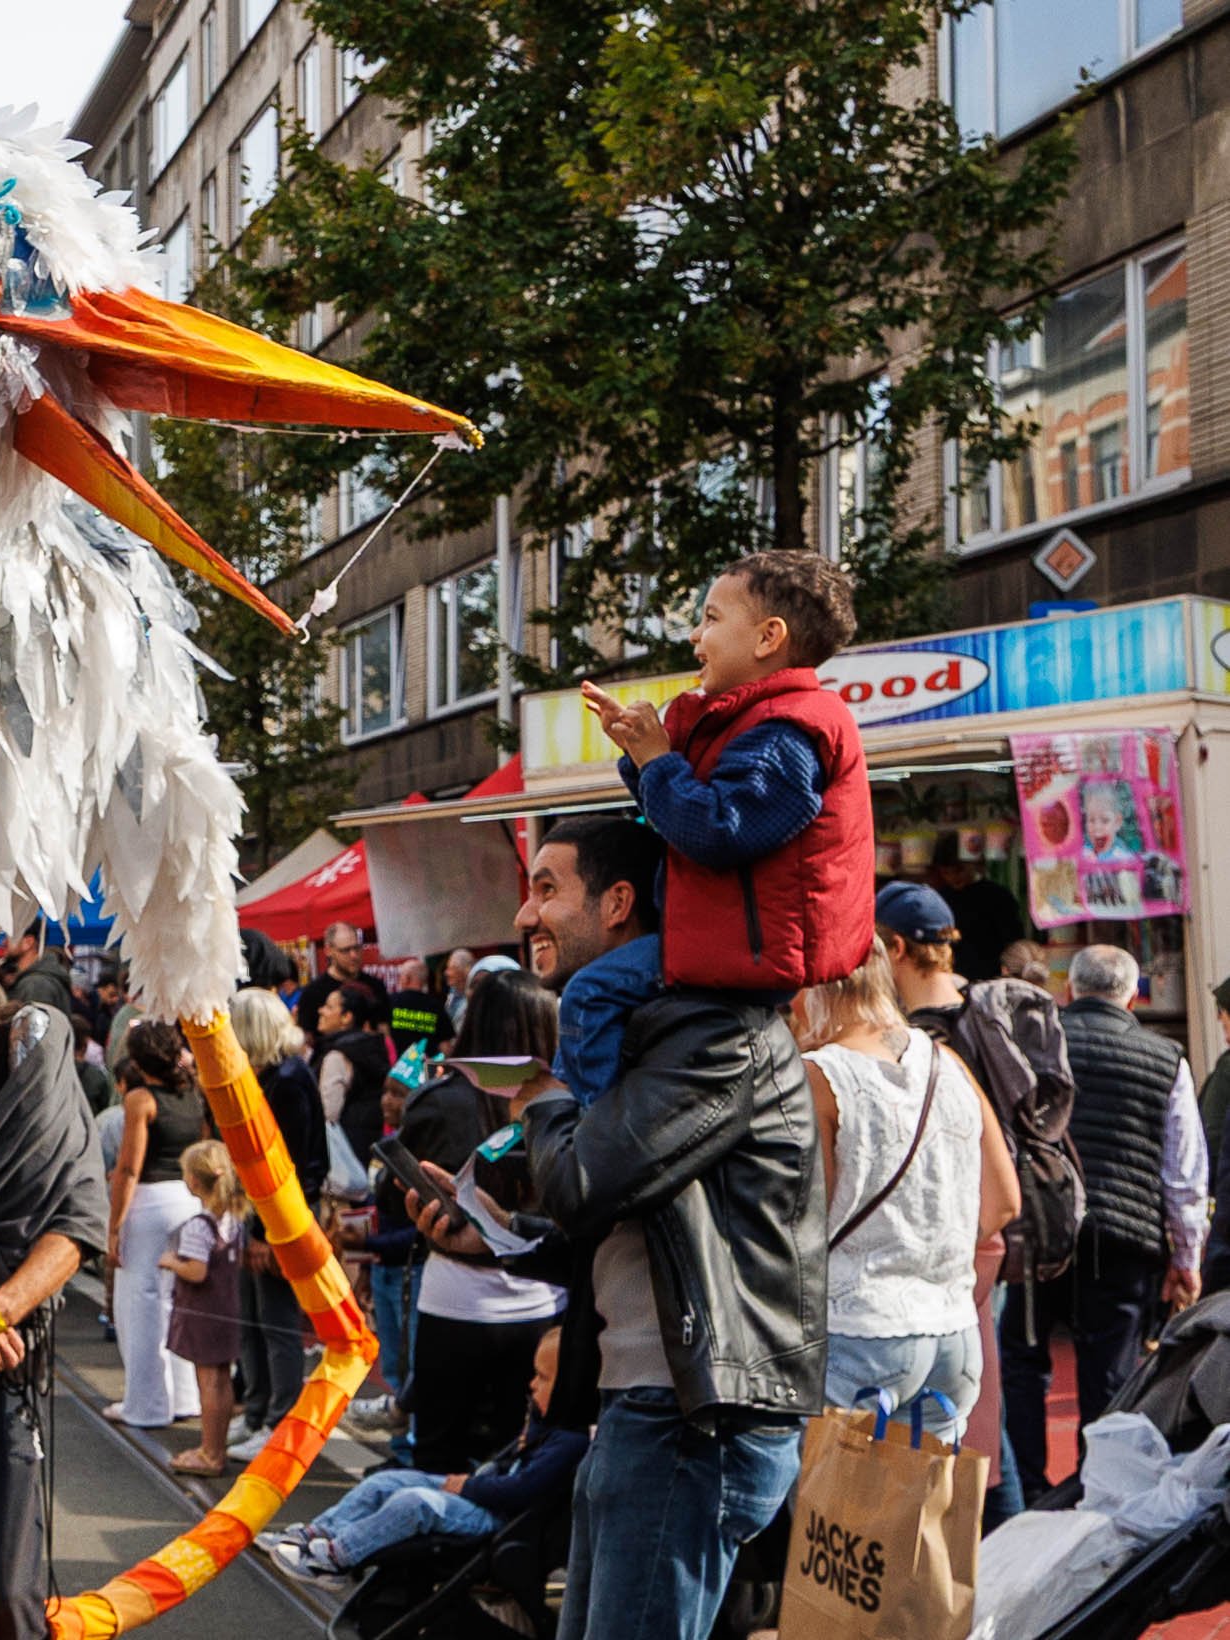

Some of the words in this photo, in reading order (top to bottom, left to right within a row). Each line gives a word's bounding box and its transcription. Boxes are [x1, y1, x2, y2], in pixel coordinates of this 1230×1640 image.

[821, 660, 961, 702] ood
[806, 1510, 862, 1569] JACK
[862, 1541, 885, 1578] &
[800, 1545, 882, 1613] JONES
